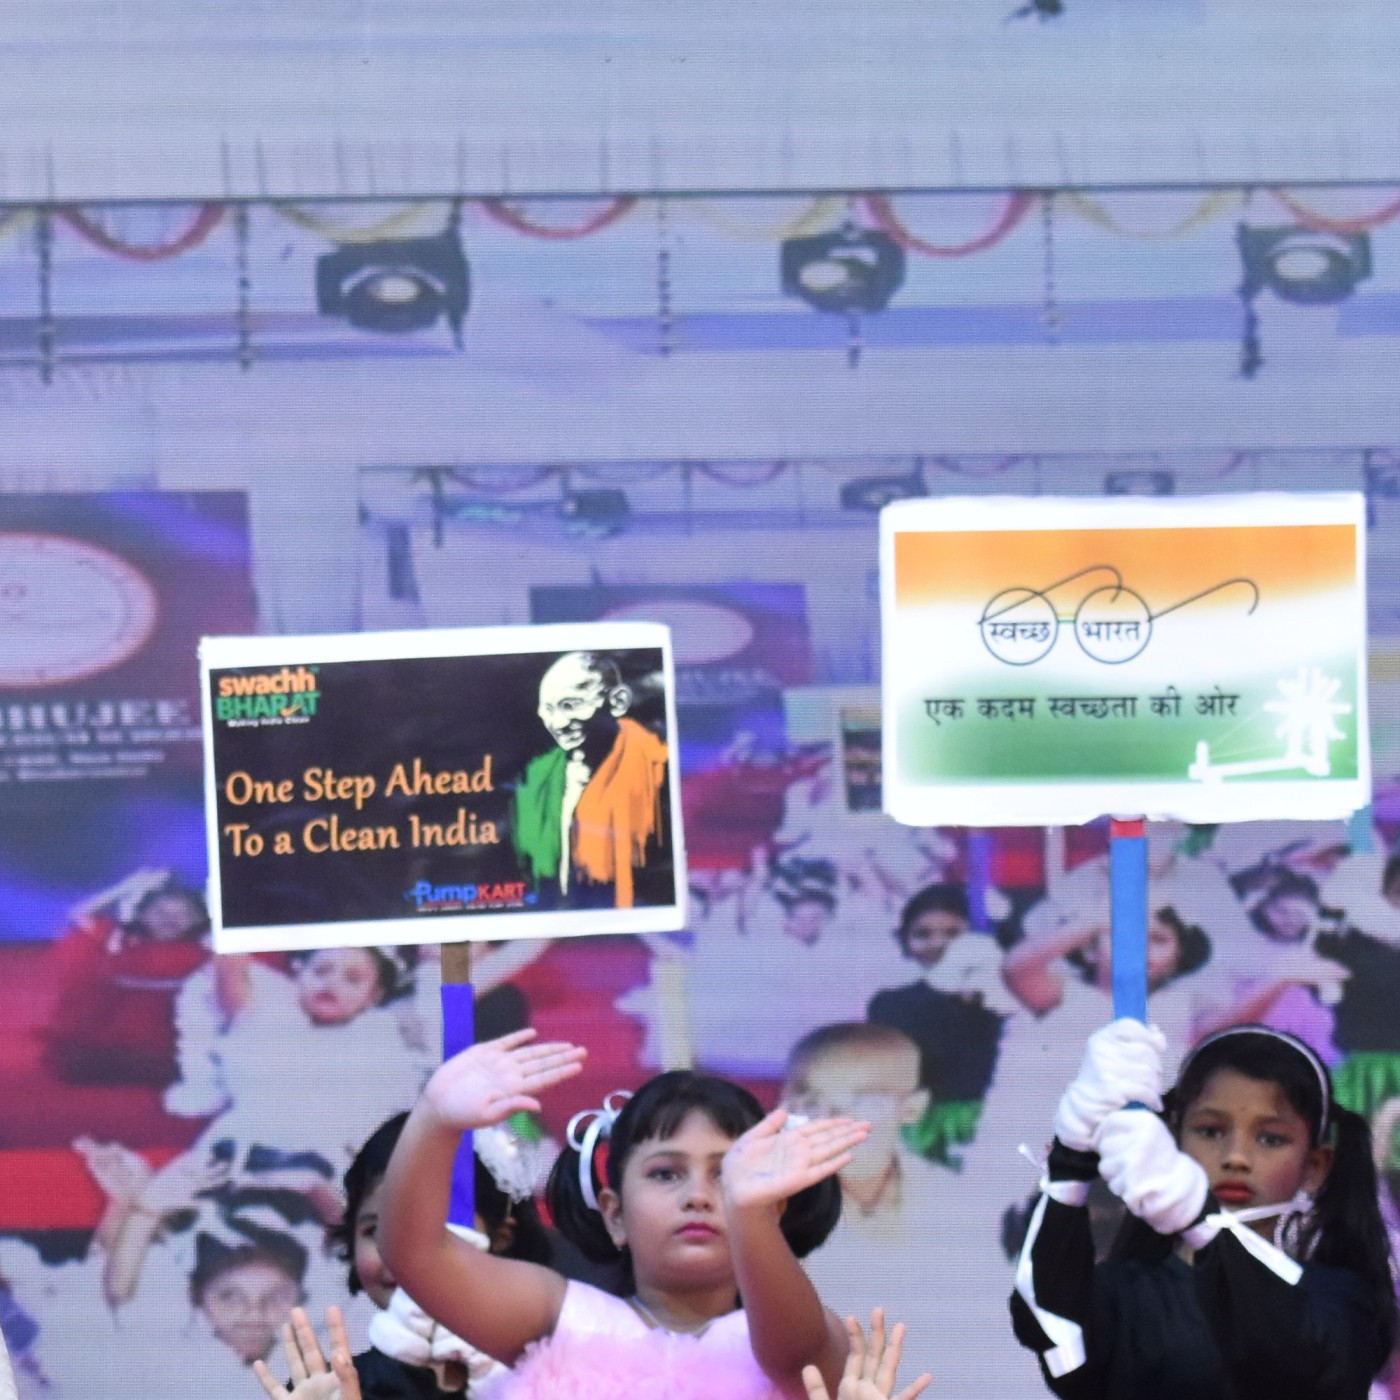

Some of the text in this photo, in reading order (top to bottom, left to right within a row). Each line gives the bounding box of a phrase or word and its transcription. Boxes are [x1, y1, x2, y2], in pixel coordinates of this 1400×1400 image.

[988, 620, 1141, 642] स्वच्छ भारत
[219, 667, 316, 697] swachh
[217, 690, 320, 720] BHARAT
[925, 685, 1240, 726] एक कदम स्वच्छता की ओर
[225, 754, 493, 810] One Step Ahead
[224, 808, 499, 857] To a Clean India
